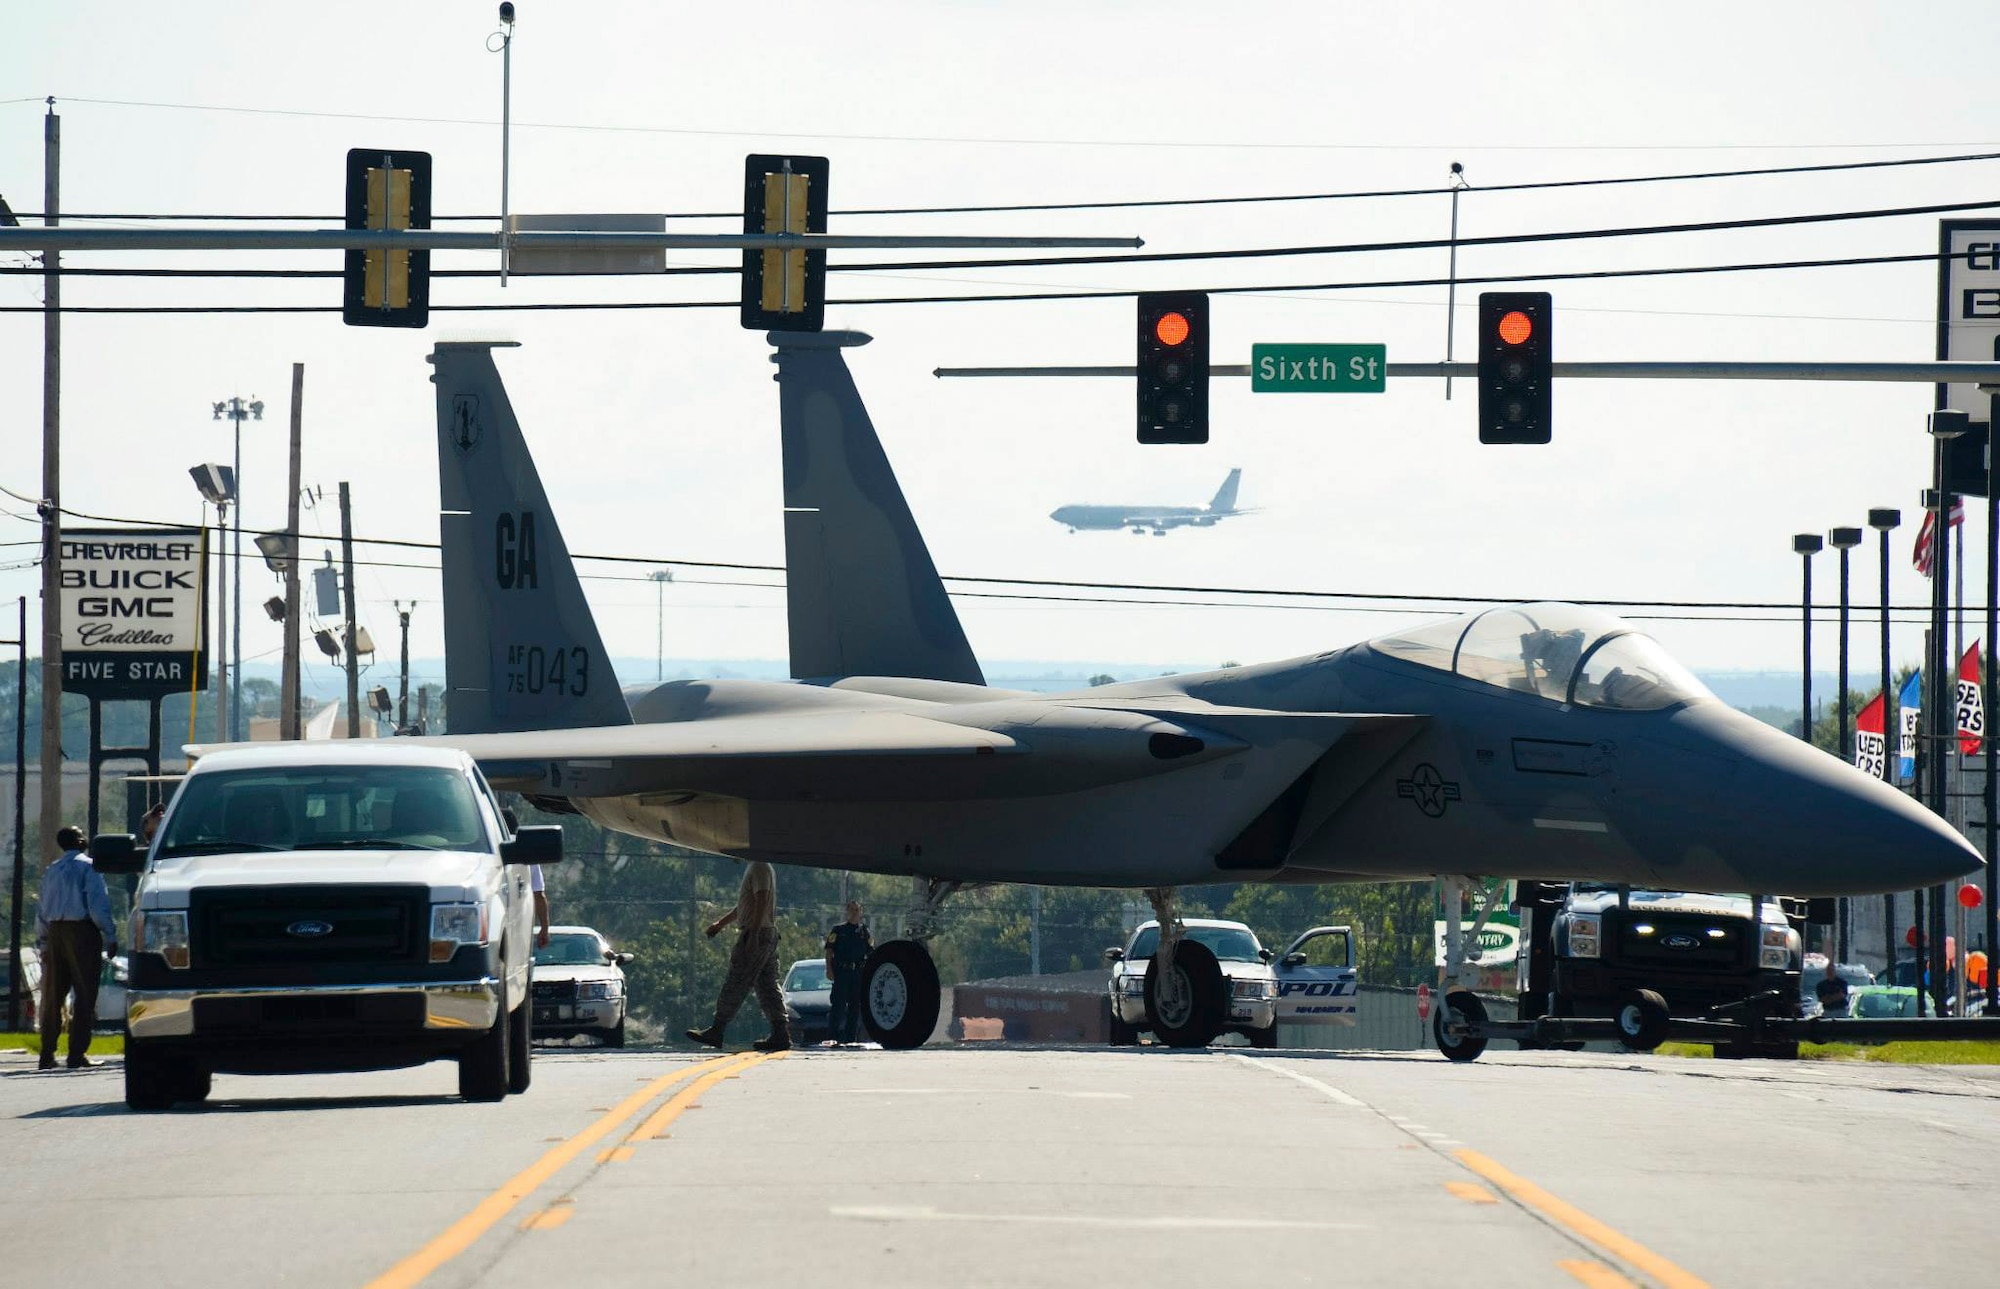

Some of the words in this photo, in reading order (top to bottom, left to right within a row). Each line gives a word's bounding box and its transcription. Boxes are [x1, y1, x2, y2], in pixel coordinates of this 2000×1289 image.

[1259, 356, 1337, 381] Sixth
[1349, 356, 1378, 381] St
[60, 541, 195, 561] CHEVROLET
[496, 511, 538, 590] GA
[61, 570, 196, 589] BUICK
[78, 597, 174, 618] GMC
[77, 622, 174, 647] Cadillac
[508, 645, 525, 664] AF
[69, 662, 115, 680] FIVE
[129, 661, 182, 680] STAR
[527, 646, 590, 697] 043
[508, 672, 525, 693] 75
